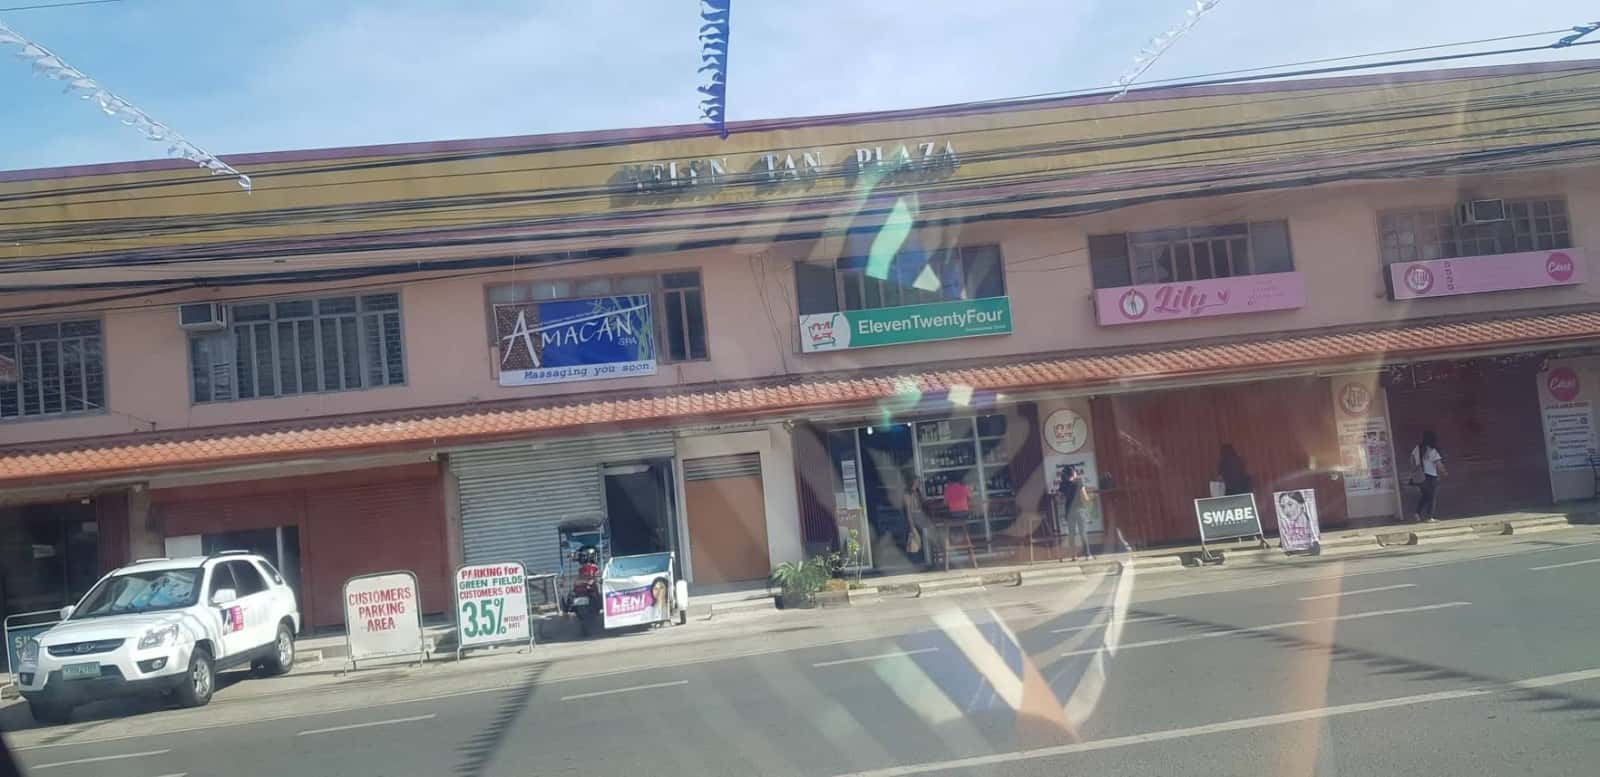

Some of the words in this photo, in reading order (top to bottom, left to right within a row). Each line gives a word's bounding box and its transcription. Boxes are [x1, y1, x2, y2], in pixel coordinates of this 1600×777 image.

[758, 150, 826, 181] TAN
[1153, 285, 1209, 315] Lily
[857, 308, 1004, 335] ElevenTwentyFour
[524, 367, 588, 381] Massaging
[593, 365, 616, 378] you
[1203, 506, 1255, 524] SWABE
[461, 567, 503, 580] PARKING
[504, 565, 521, 576] for
[458, 579, 488, 590] GREEN
[492, 575, 523, 586] FIELDS
[349, 586, 412, 606] CUSTOMERS
[459, 586, 504, 599] CUSTOMERS
[505, 585, 525, 595] ONLY
[358, 601, 406, 620] PARKING
[611, 594, 646, 610] LENI
[367, 617, 396, 632] AREA
[462, 598, 507, 638] 3.5%
